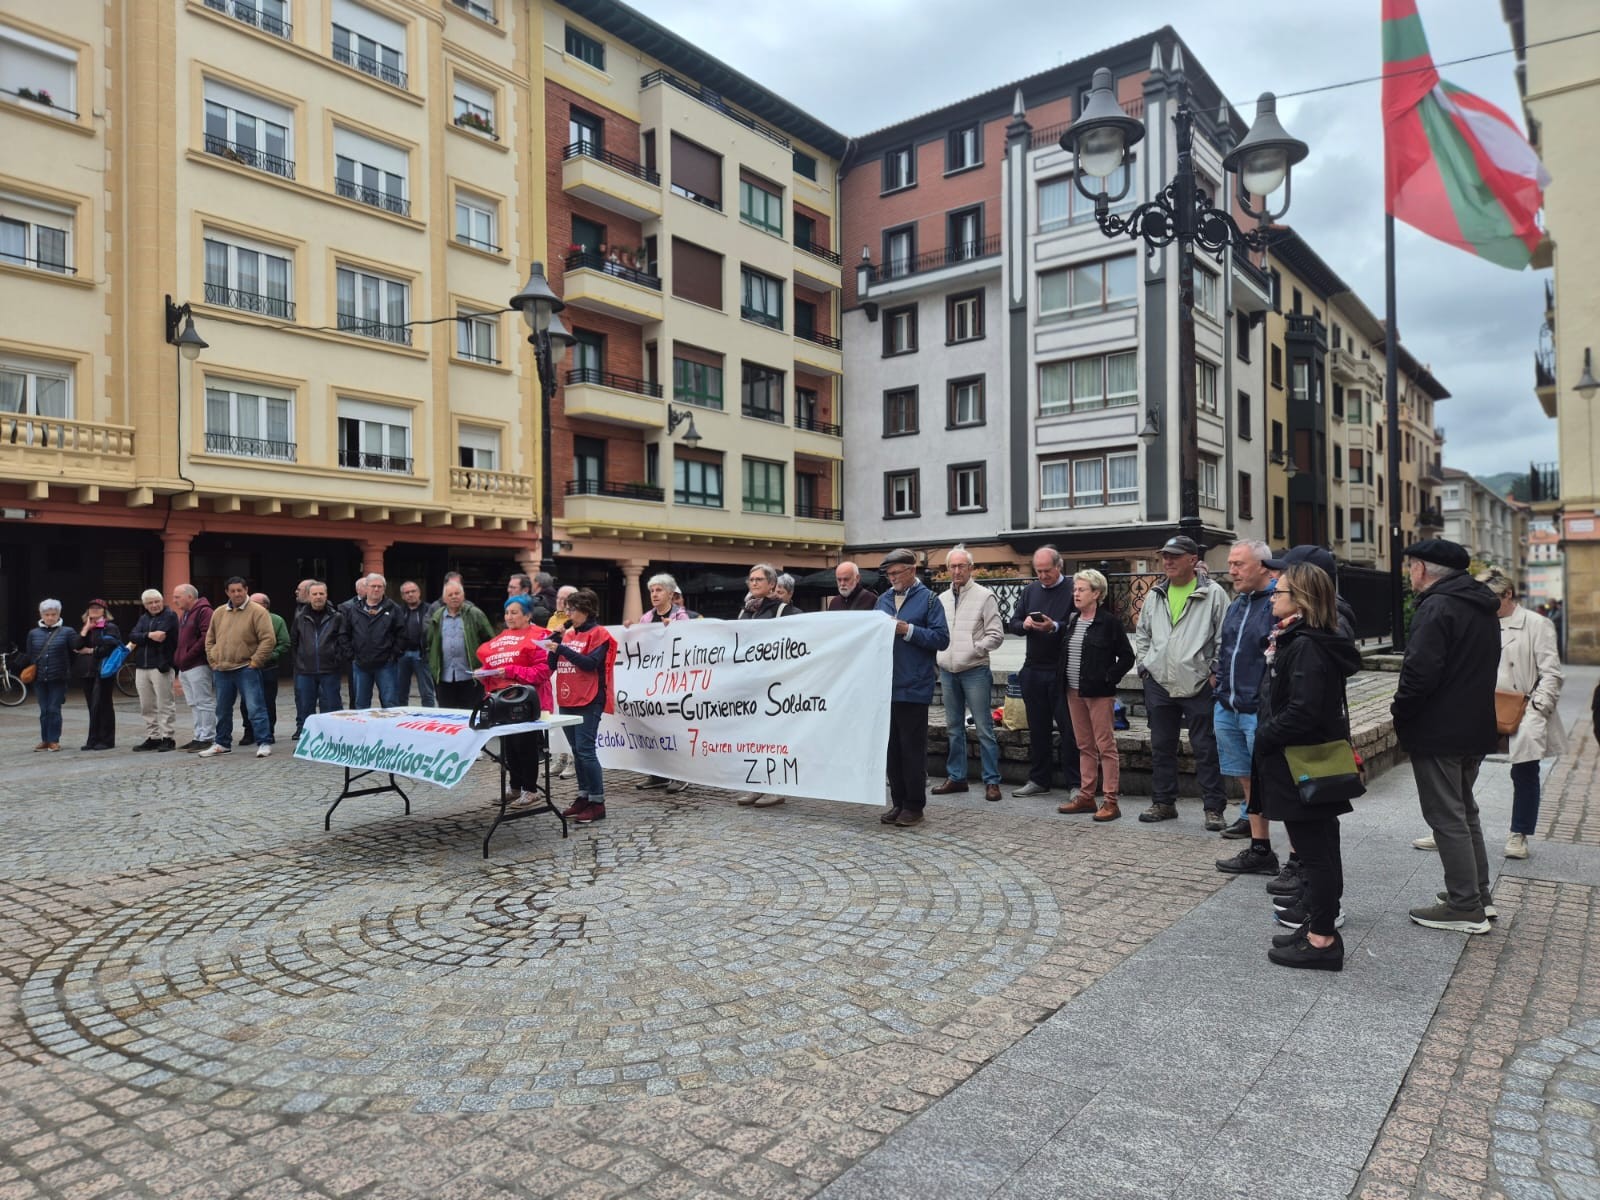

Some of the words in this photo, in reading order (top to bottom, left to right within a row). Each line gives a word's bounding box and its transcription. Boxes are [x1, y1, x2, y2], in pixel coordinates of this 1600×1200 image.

[671, 637, 726, 669] Ekimen
[733, 632, 811, 664] Legegilea
[765, 682, 827, 716] Soldata
[595, 730, 625, 751] edoko
[688, 728, 699, 757] 7
[702, 741, 732, 757] garren
